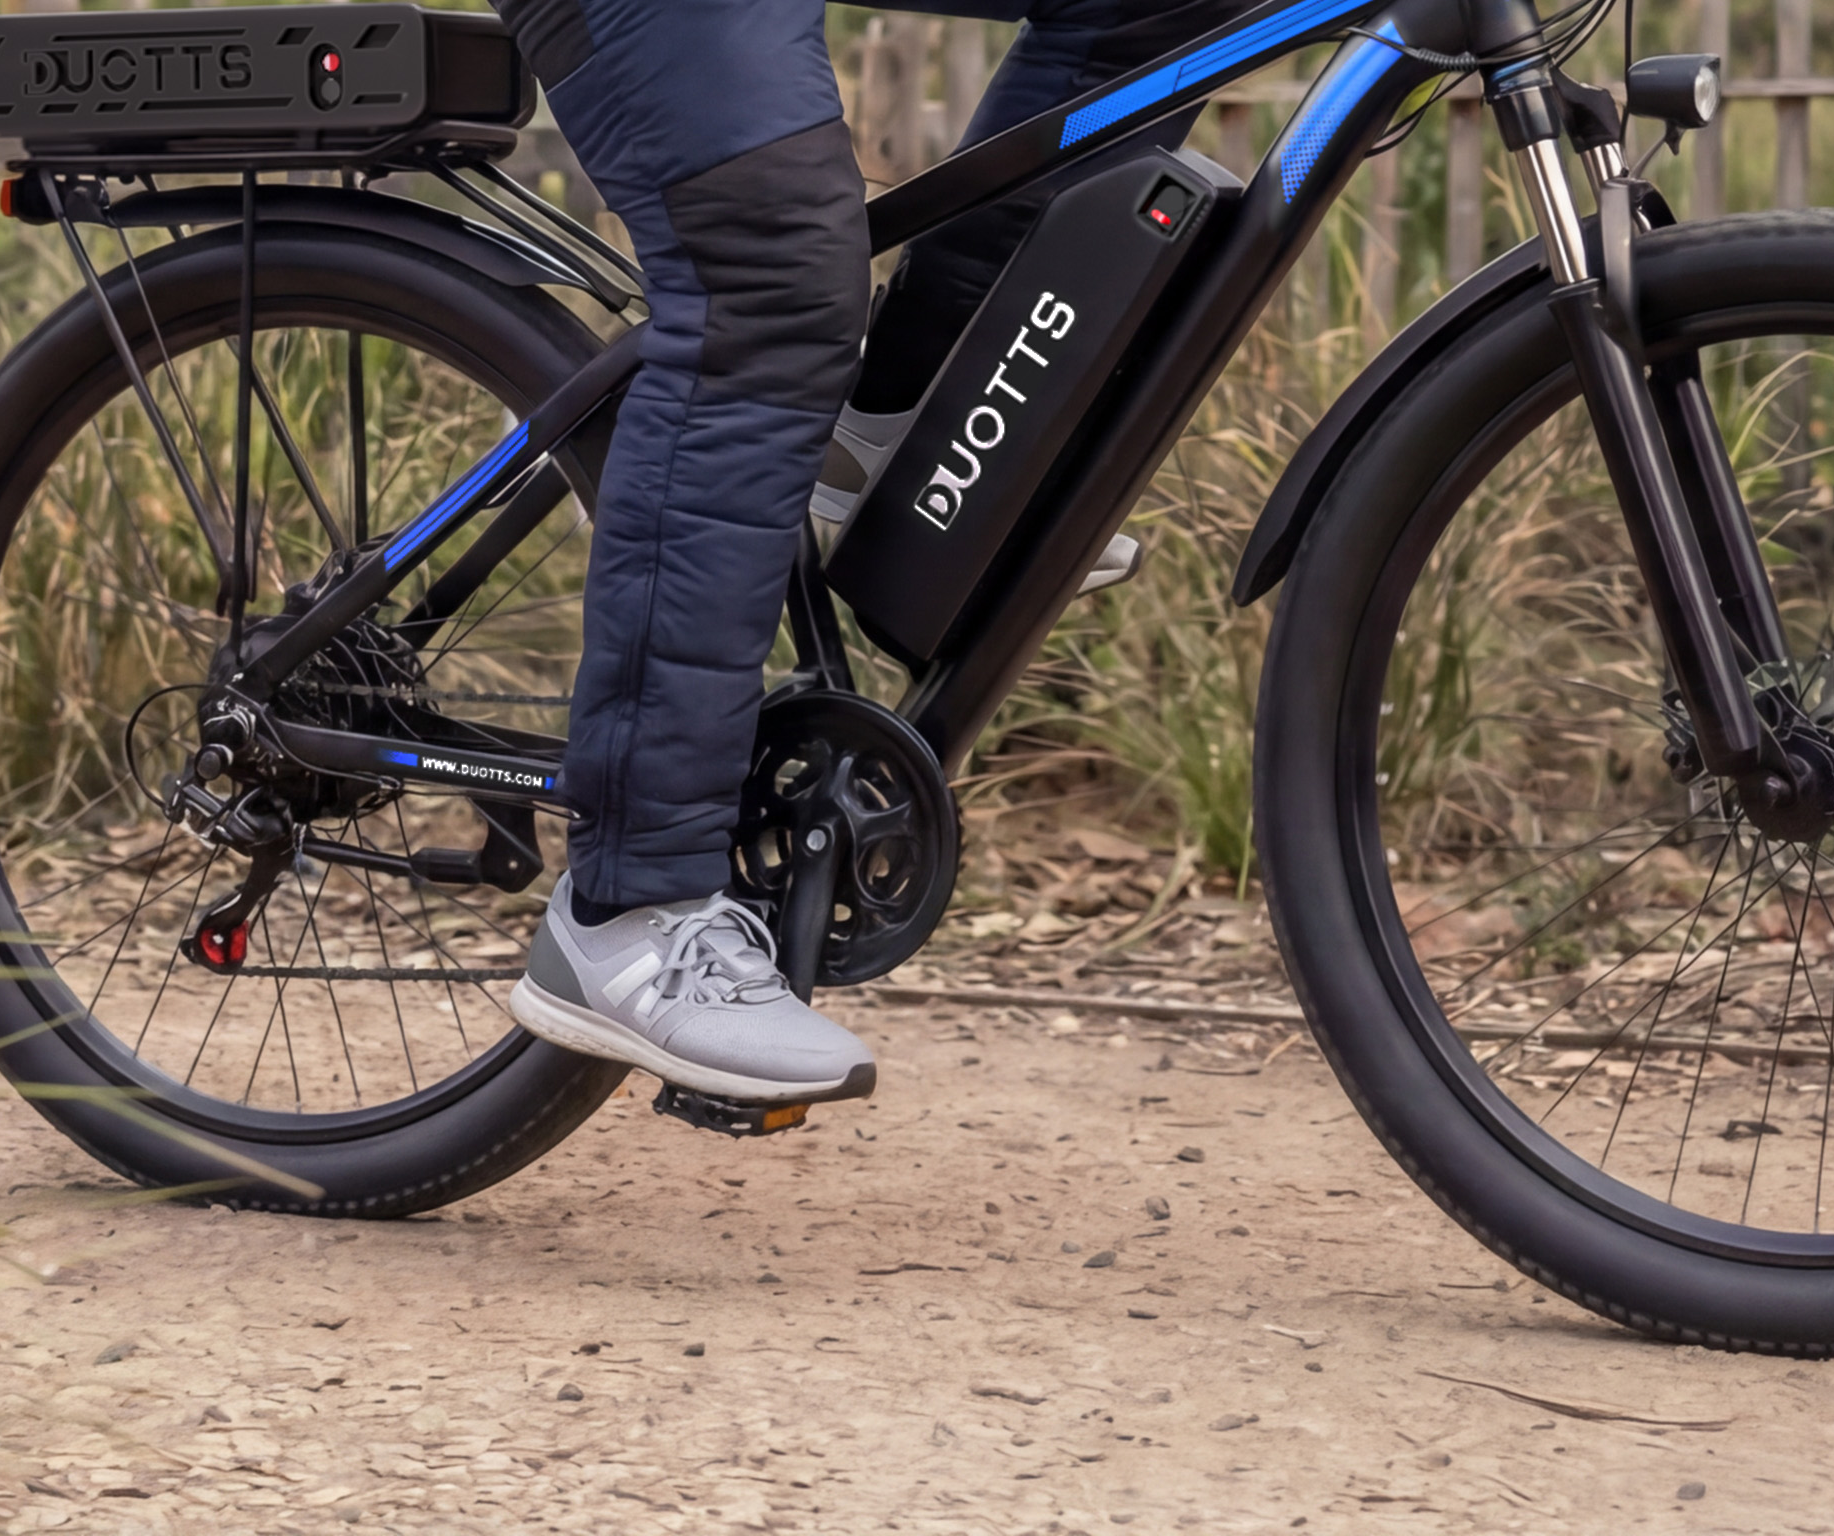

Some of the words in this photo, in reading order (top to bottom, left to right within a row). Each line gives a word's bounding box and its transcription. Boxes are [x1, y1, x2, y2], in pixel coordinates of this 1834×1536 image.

[23, 43, 253, 95] DUOTTS
[914, 291, 1076, 530] DUOTTS
[422, 756, 543, 787] WWW.DUOTTS.COM
